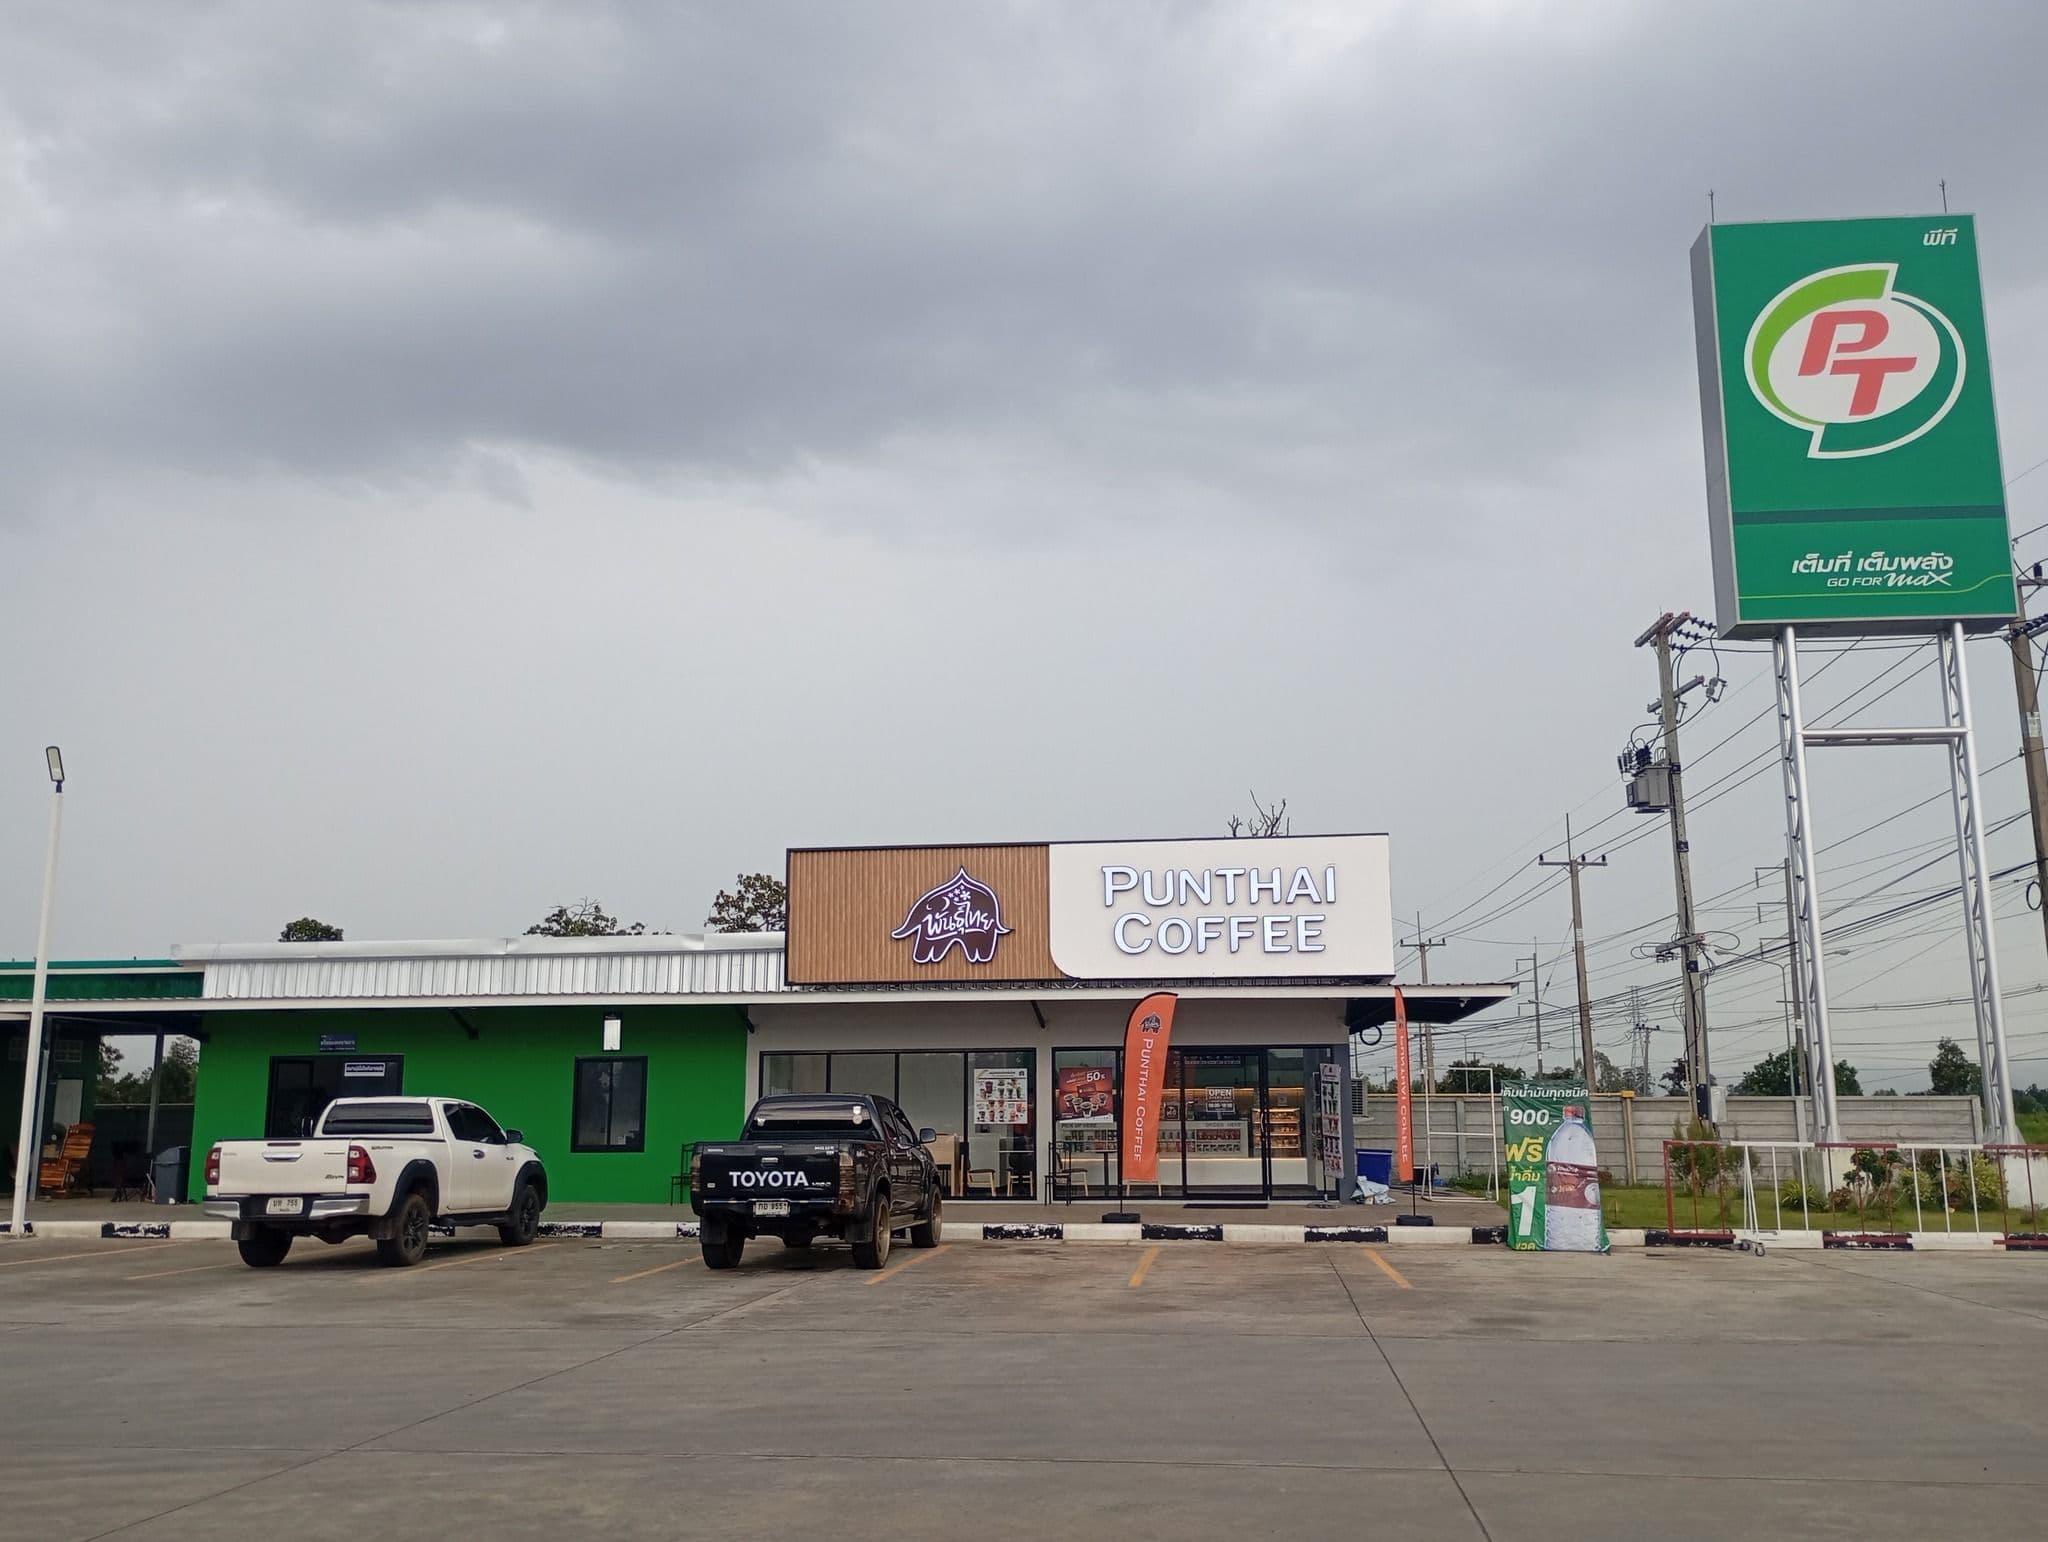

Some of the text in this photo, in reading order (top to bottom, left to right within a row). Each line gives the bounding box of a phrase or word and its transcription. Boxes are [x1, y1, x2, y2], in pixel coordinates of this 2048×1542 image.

[1922, 228, 1959, 246] พีที
[1798, 309, 1918, 417] PT
[1791, 550, 1953, 573] เต็มที่ เต็มพลัง
[1827, 577, 1850, 588] GO
[1852, 577, 1882, 587] FOR
[1100, 864, 1337, 907] PUNTHAI
[1113, 911, 1326, 955] COFFEE
[1136, 1037, 1154, 1101] PUNTHAI
[1505, 1136, 1544, 1163] ฟรี
[729, 1171, 809, 1187] TOYOTA
[1511, 1186, 1537, 1236] 1
